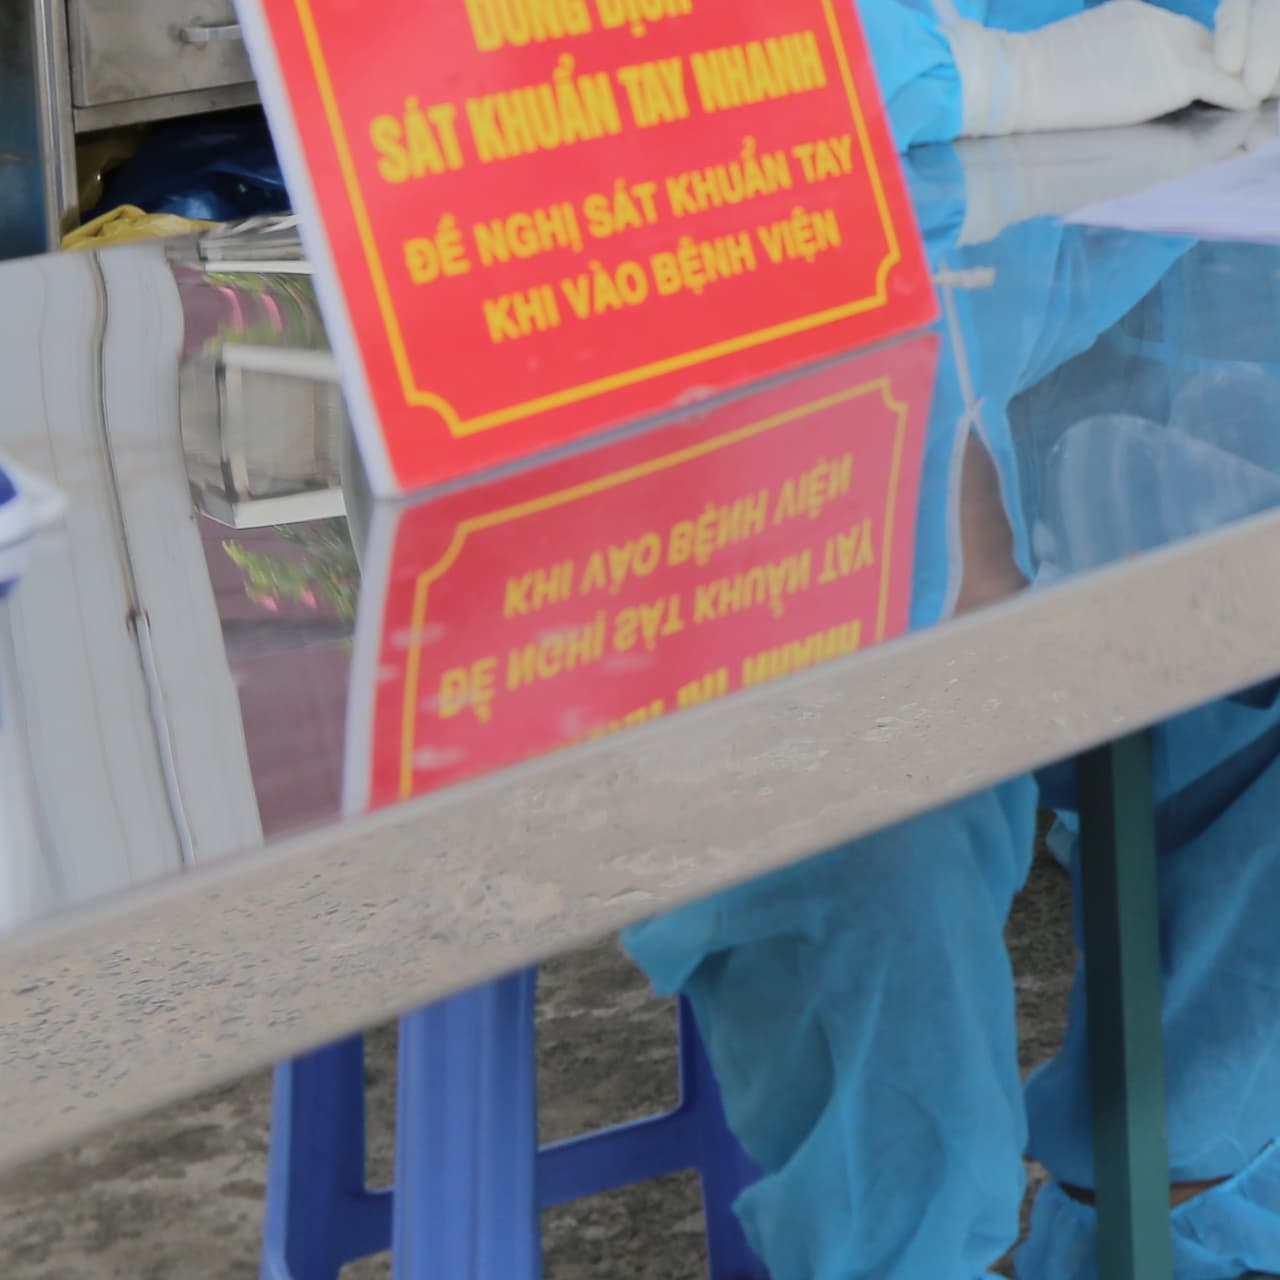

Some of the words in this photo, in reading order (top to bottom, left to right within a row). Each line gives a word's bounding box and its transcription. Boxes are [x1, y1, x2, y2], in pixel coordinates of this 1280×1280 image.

[369, 94, 464, 185] SÁT
[465, 52, 622, 164] KHUẨN
[616, 56, 690, 128] TAY
[690, 30, 827, 114] NHANH
[473, 201, 584, 268] NGHỊ
[583, 177, 660, 239] SÁT
[793, 134, 853, 184] TAY
[482, 283, 561, 344] KHI
[561, 259, 650, 320] VÀO
[650, 235, 757, 296] BỆNH
[757, 205, 842, 265] VIỆN
